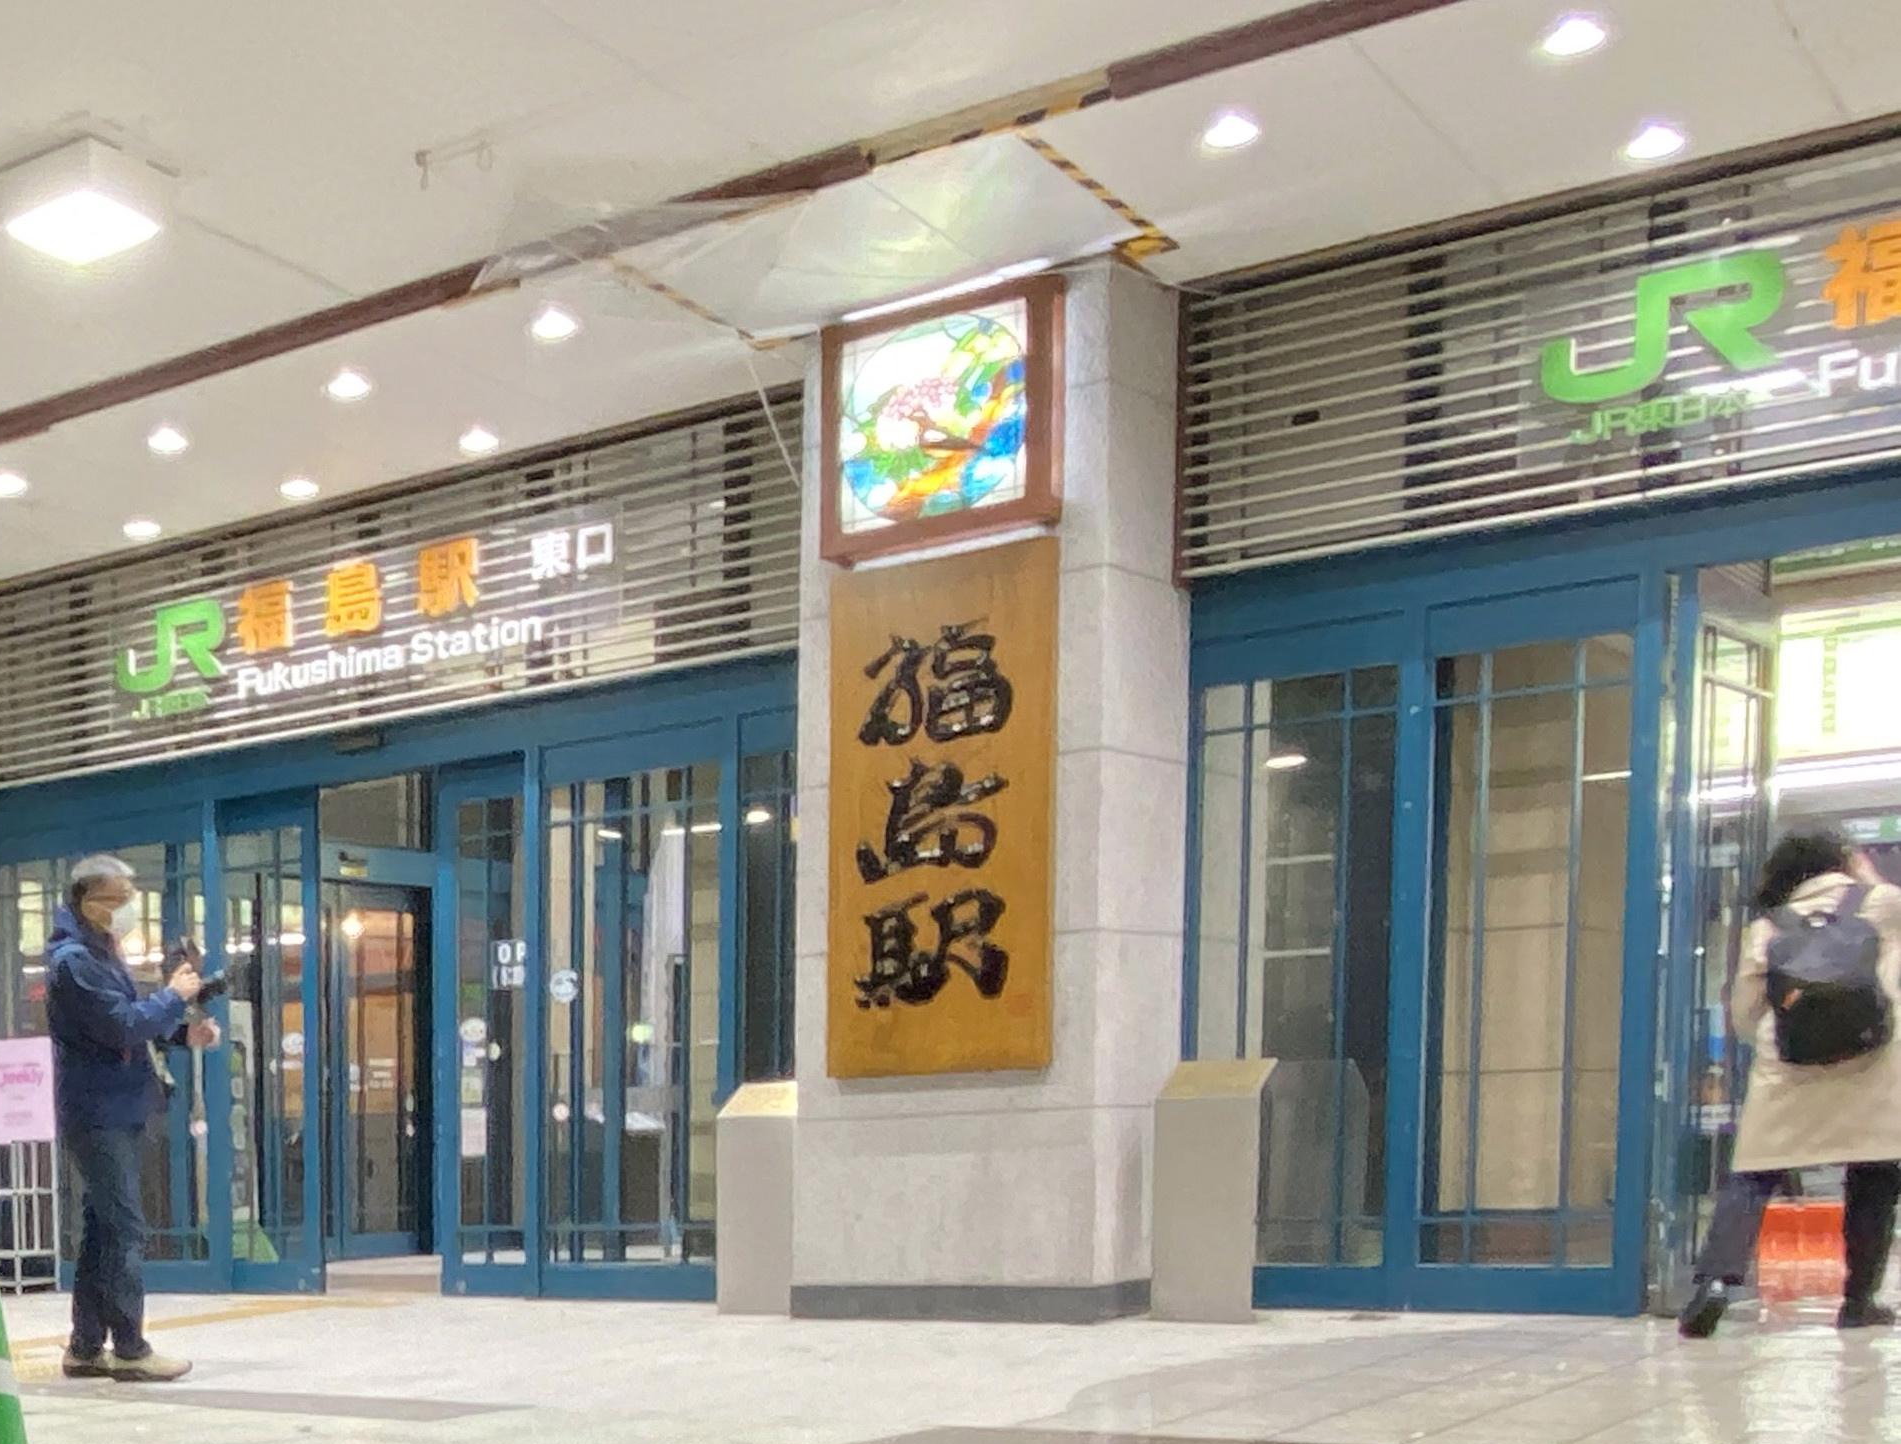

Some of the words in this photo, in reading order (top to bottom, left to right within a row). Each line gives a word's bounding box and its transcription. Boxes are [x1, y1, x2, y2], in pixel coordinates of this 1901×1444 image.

[1540, 249, 1785, 403] JR
[530, 523, 613, 580] 東口
[116, 598, 226, 693] JR
[237, 646, 405, 698] Fukushima
[410, 616, 543, 664] Station
[854, 620, 1014, 1010] 福島駅
